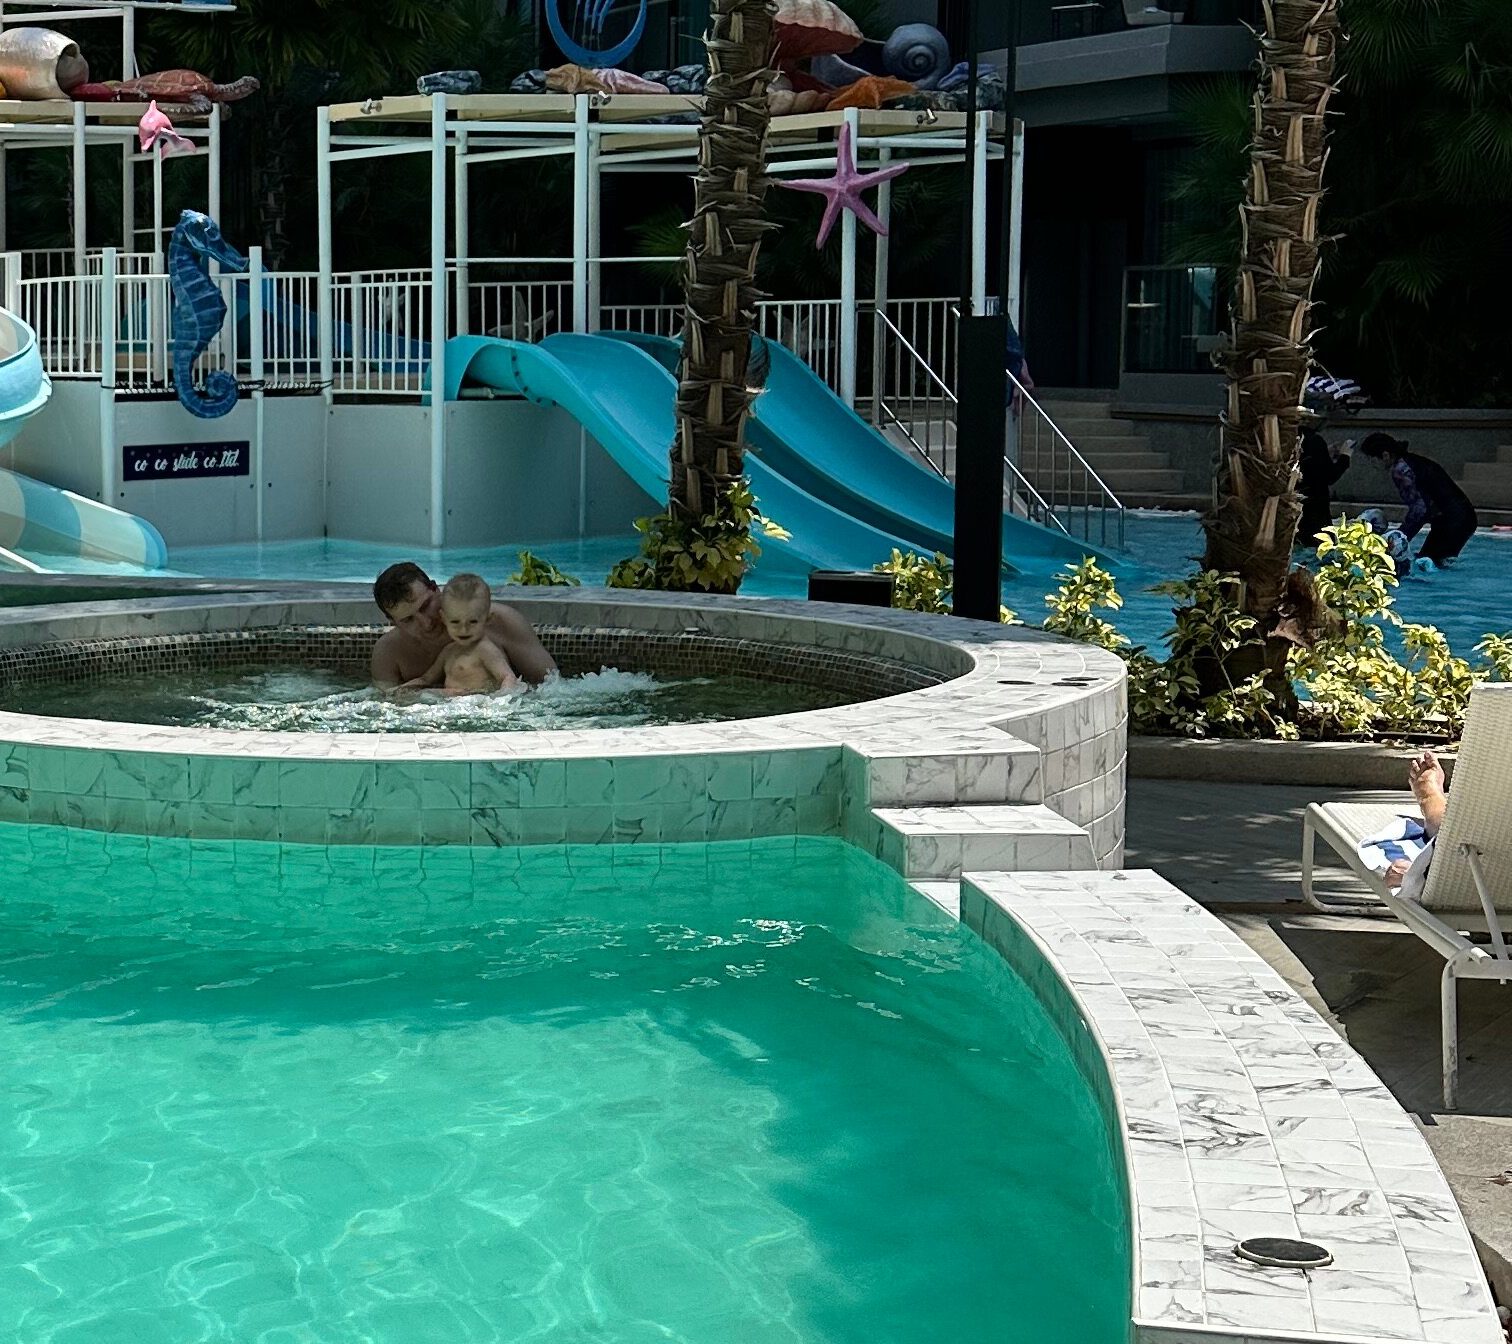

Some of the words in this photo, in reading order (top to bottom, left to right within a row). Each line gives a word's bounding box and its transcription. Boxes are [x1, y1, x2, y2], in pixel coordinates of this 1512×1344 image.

[134, 459, 148, 471] co
[154, 458, 168, 471] co
[172, 450, 199, 471] slide
